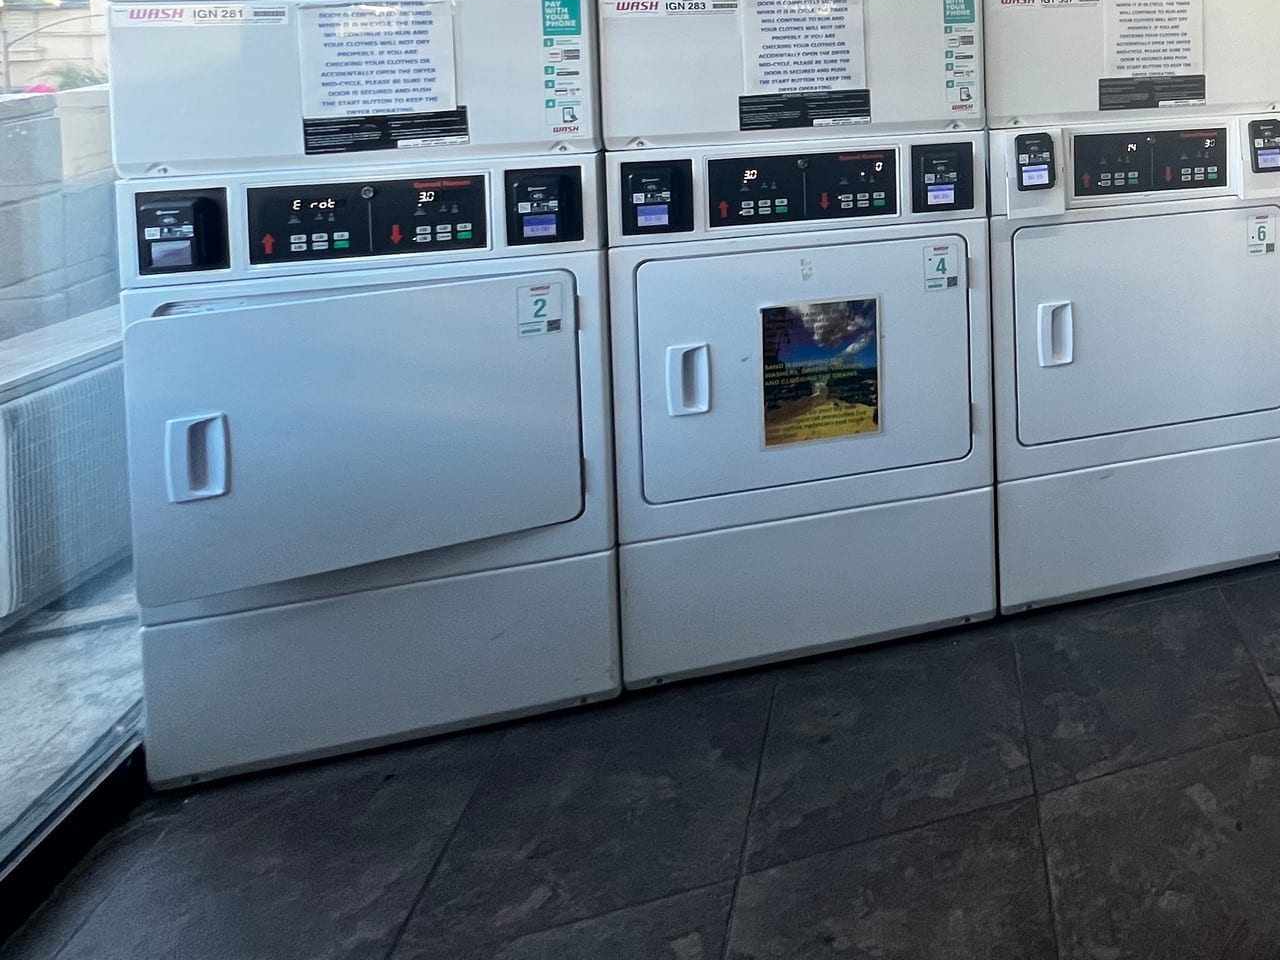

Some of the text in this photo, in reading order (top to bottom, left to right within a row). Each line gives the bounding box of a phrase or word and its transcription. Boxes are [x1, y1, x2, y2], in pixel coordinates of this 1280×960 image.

[616, 2, 659, 10] WASH
[130, 8, 243, 19] WASH IGN 281
[875, 162, 882, 171] 0
[1258, 226, 1266, 241] 6
[936, 258, 947, 274] 4
[534, 298, 547, 318] 2
